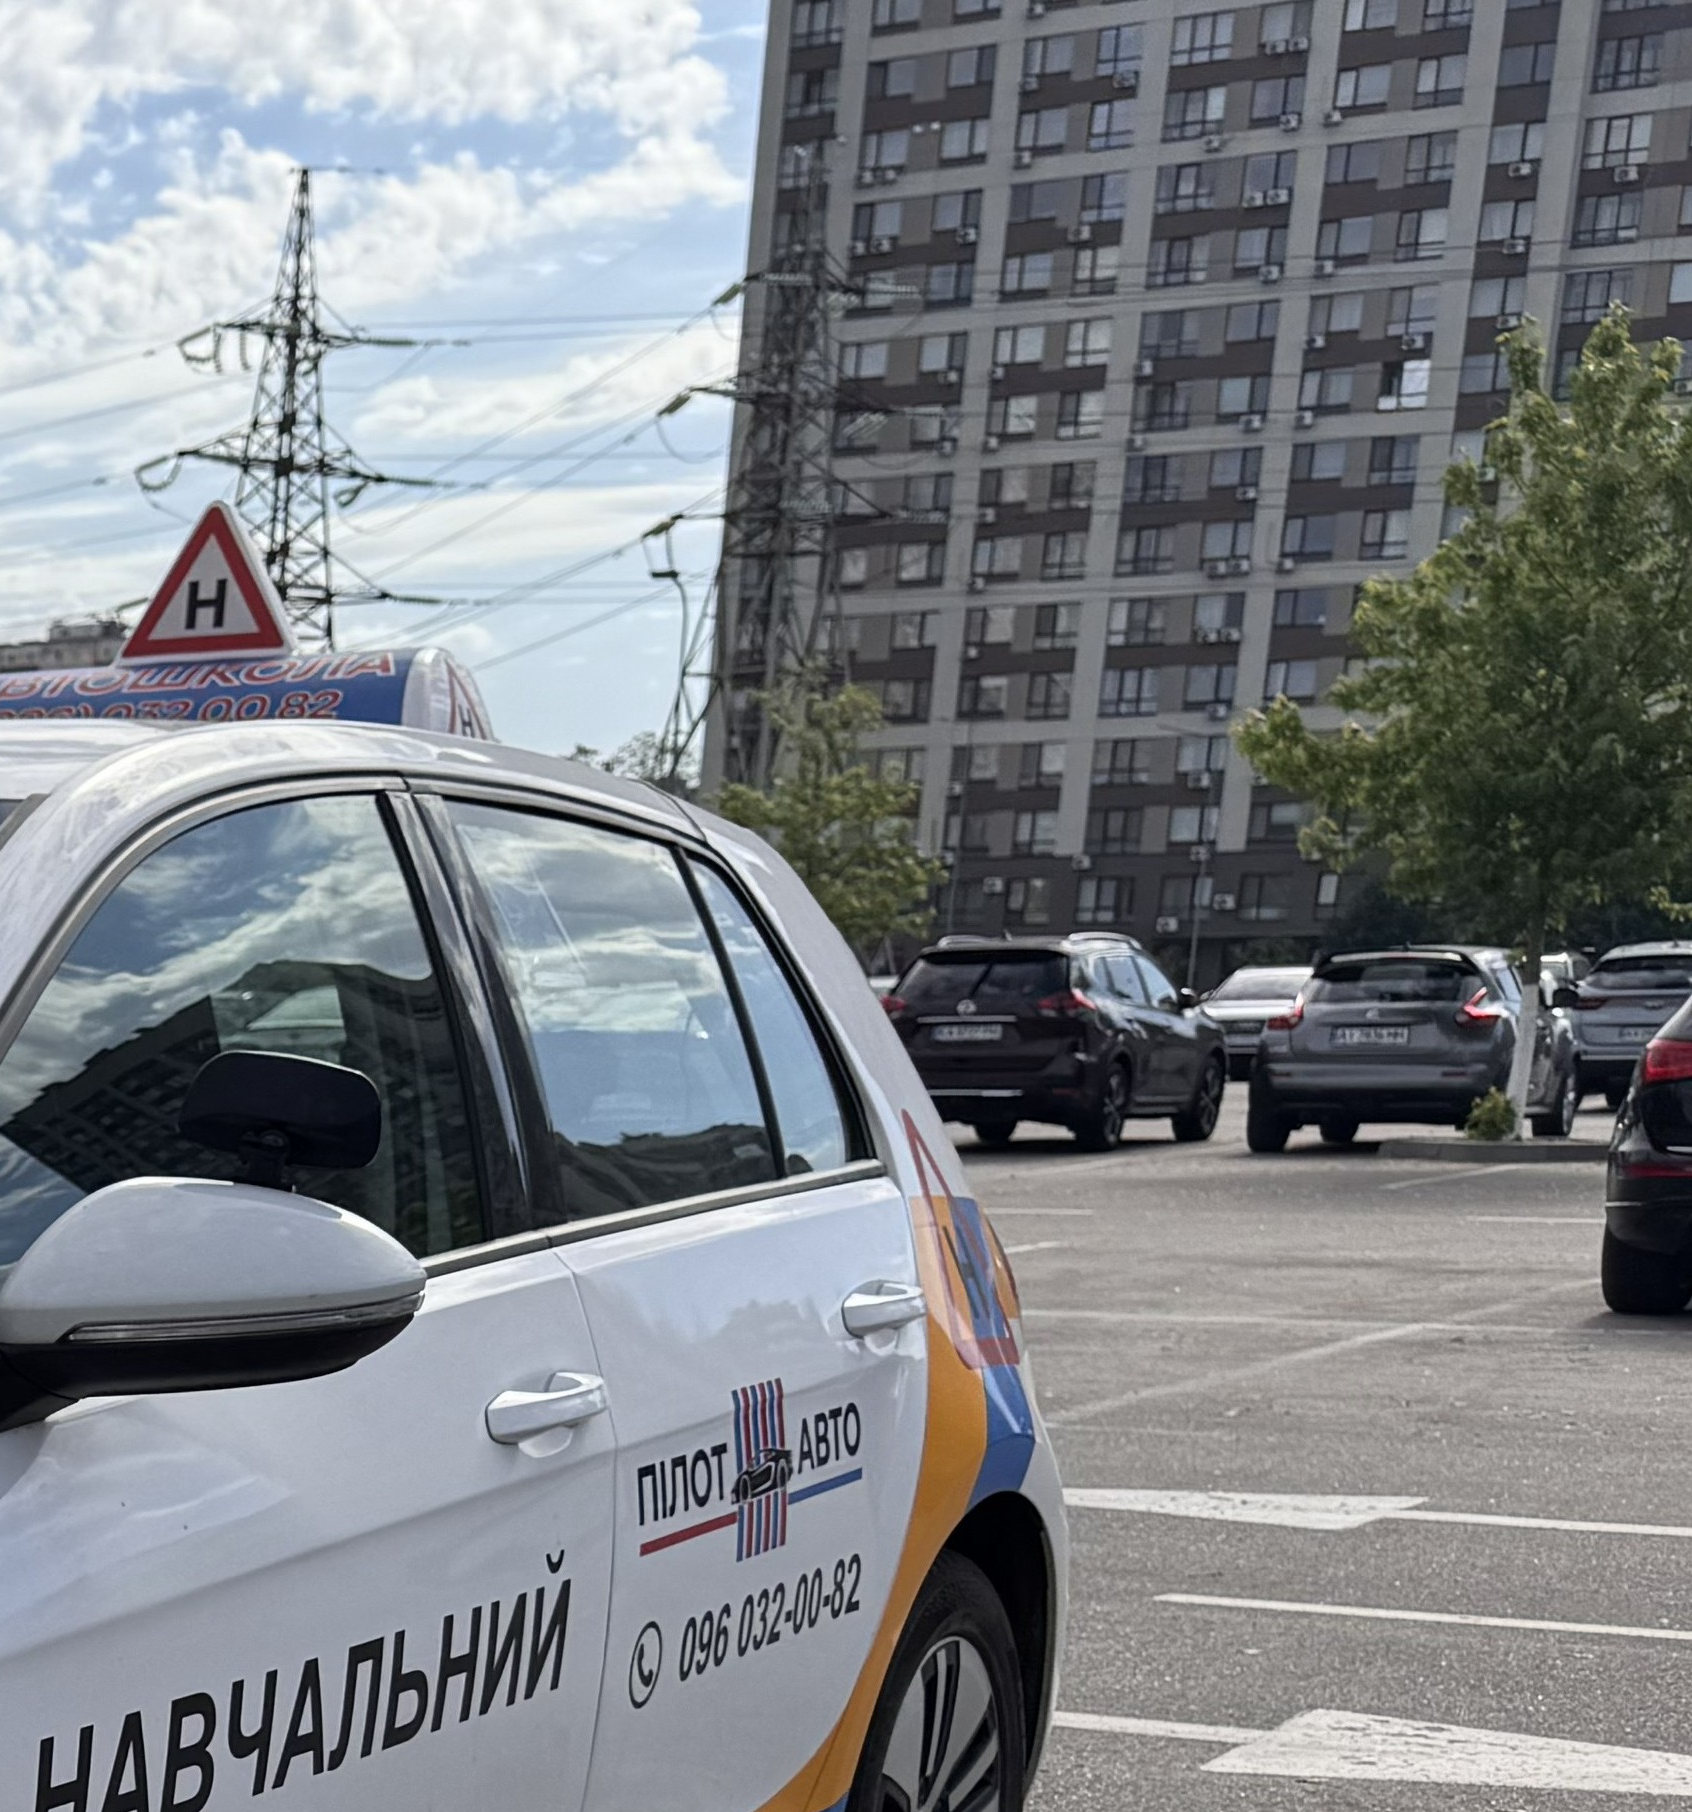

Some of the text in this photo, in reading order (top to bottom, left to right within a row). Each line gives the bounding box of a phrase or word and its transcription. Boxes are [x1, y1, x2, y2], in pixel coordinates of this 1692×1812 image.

[184, 578, 228, 630] Н
[637, 1402, 861, 1526] ПІЛОТ АВТО
[679, 1553, 862, 1682] 096 032-00-82
